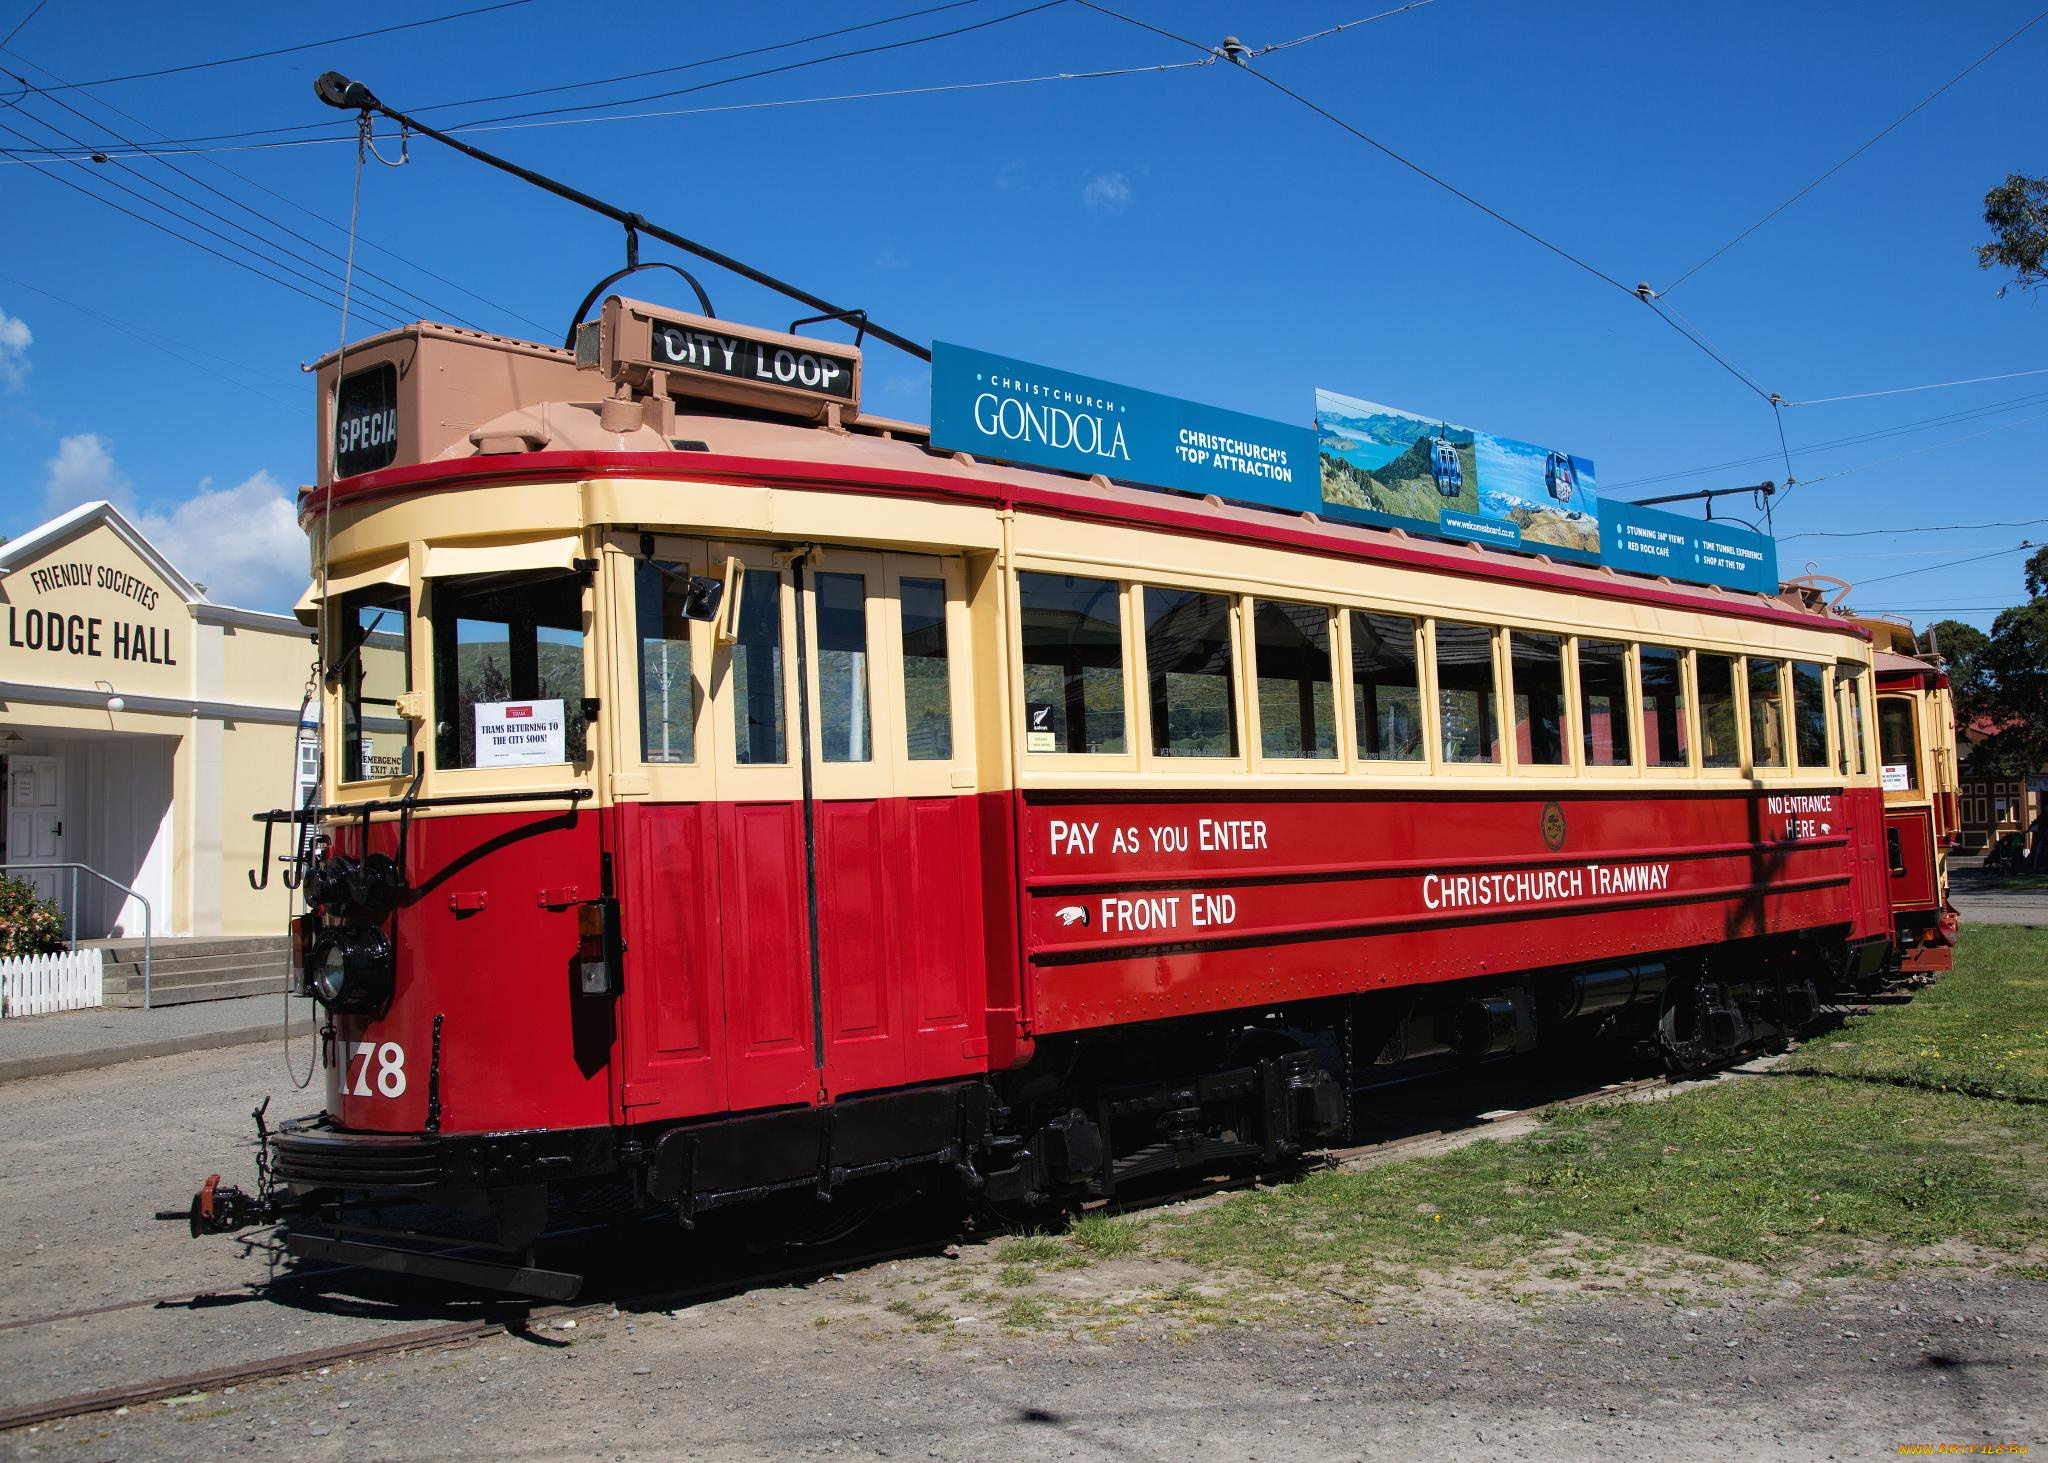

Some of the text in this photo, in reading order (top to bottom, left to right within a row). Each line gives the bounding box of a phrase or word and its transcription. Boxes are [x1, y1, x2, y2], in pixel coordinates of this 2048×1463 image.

[663, 328, 840, 388] CITY LOOP
[991, 375, 1114, 412] CHRISTCHURCH
[974, 393, 1131, 461] GONDOLA
[1179, 428, 1287, 465] CHRISTCHURCH'S
[1213, 453, 1292, 483] ATTRACTION
[1446, 518, 1515, 539] www.welcomeaboard.co.nz
[1626, 525, 1657, 540] STUNNING
[1668, 533, 1685, 545] VIEWS
[1627, 541, 1640, 552] RED
[1640, 543, 1656, 555] ROCK
[1702, 540, 1764, 561] TIME TUNNEL EXPERIENCE
[1703, 555, 1746, 571] SHOP AT THE TOP
[30, 563, 160, 611] FRIENDLY SOCIETIES
[9, 606, 177, 666] LODGE HALL
[481, 721, 559, 735] TRAMS RETURNING TO
[493, 733, 548, 746] THE CITY SOON!
[362, 755, 403, 765] EMERGENC
[370, 765, 400, 775] EXIT AT
[1767, 795, 1832, 815] NO ENTRANCE
[1050, 818, 1268, 855] PAY AS YOU ENTER
[1785, 819, 1817, 839] HERE
[1423, 864, 1670, 910] CHRISTCHURCH TRAMWAY
[1101, 893, 1236, 932] FRONT END
[337, 1040, 407, 1099] 178
